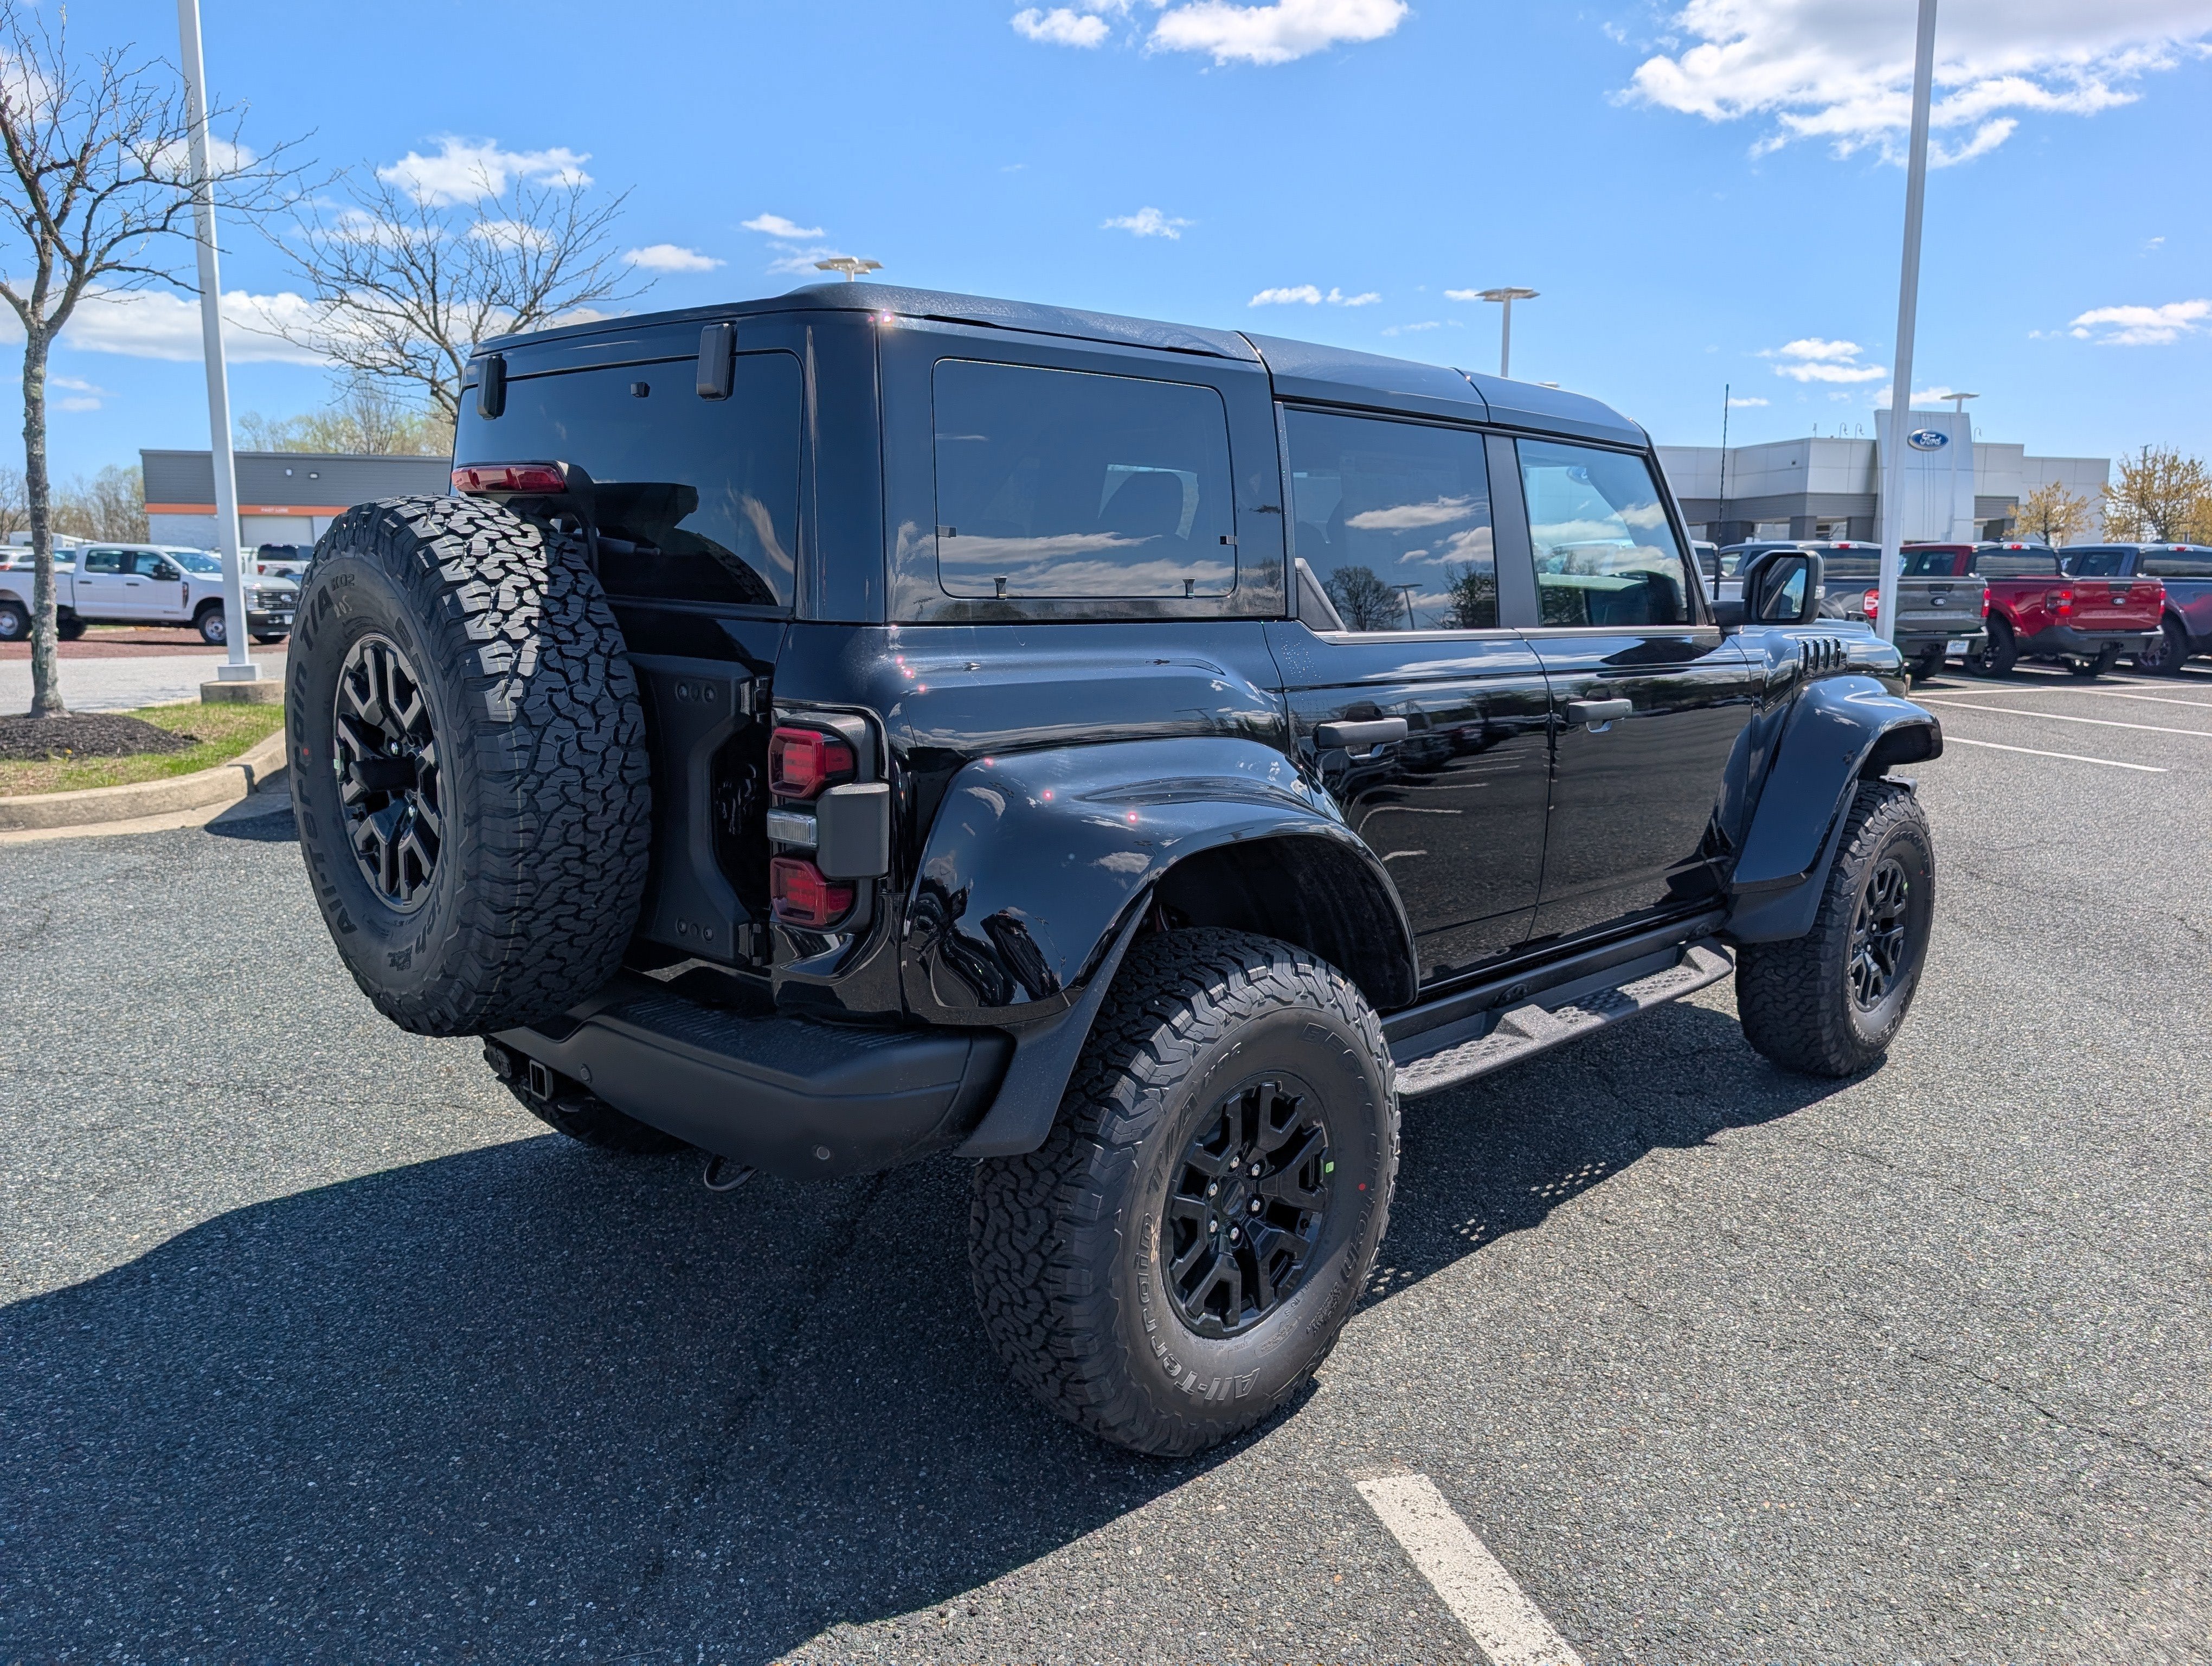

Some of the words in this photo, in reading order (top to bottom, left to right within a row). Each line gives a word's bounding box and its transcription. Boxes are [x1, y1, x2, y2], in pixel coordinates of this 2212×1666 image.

[1920, 433, 1941, 445] Ford
[300, 585, 333, 651] T/A
[292, 660, 358, 934] All-Terrain
[1134, 1213, 1261, 1401] All-Terrain
